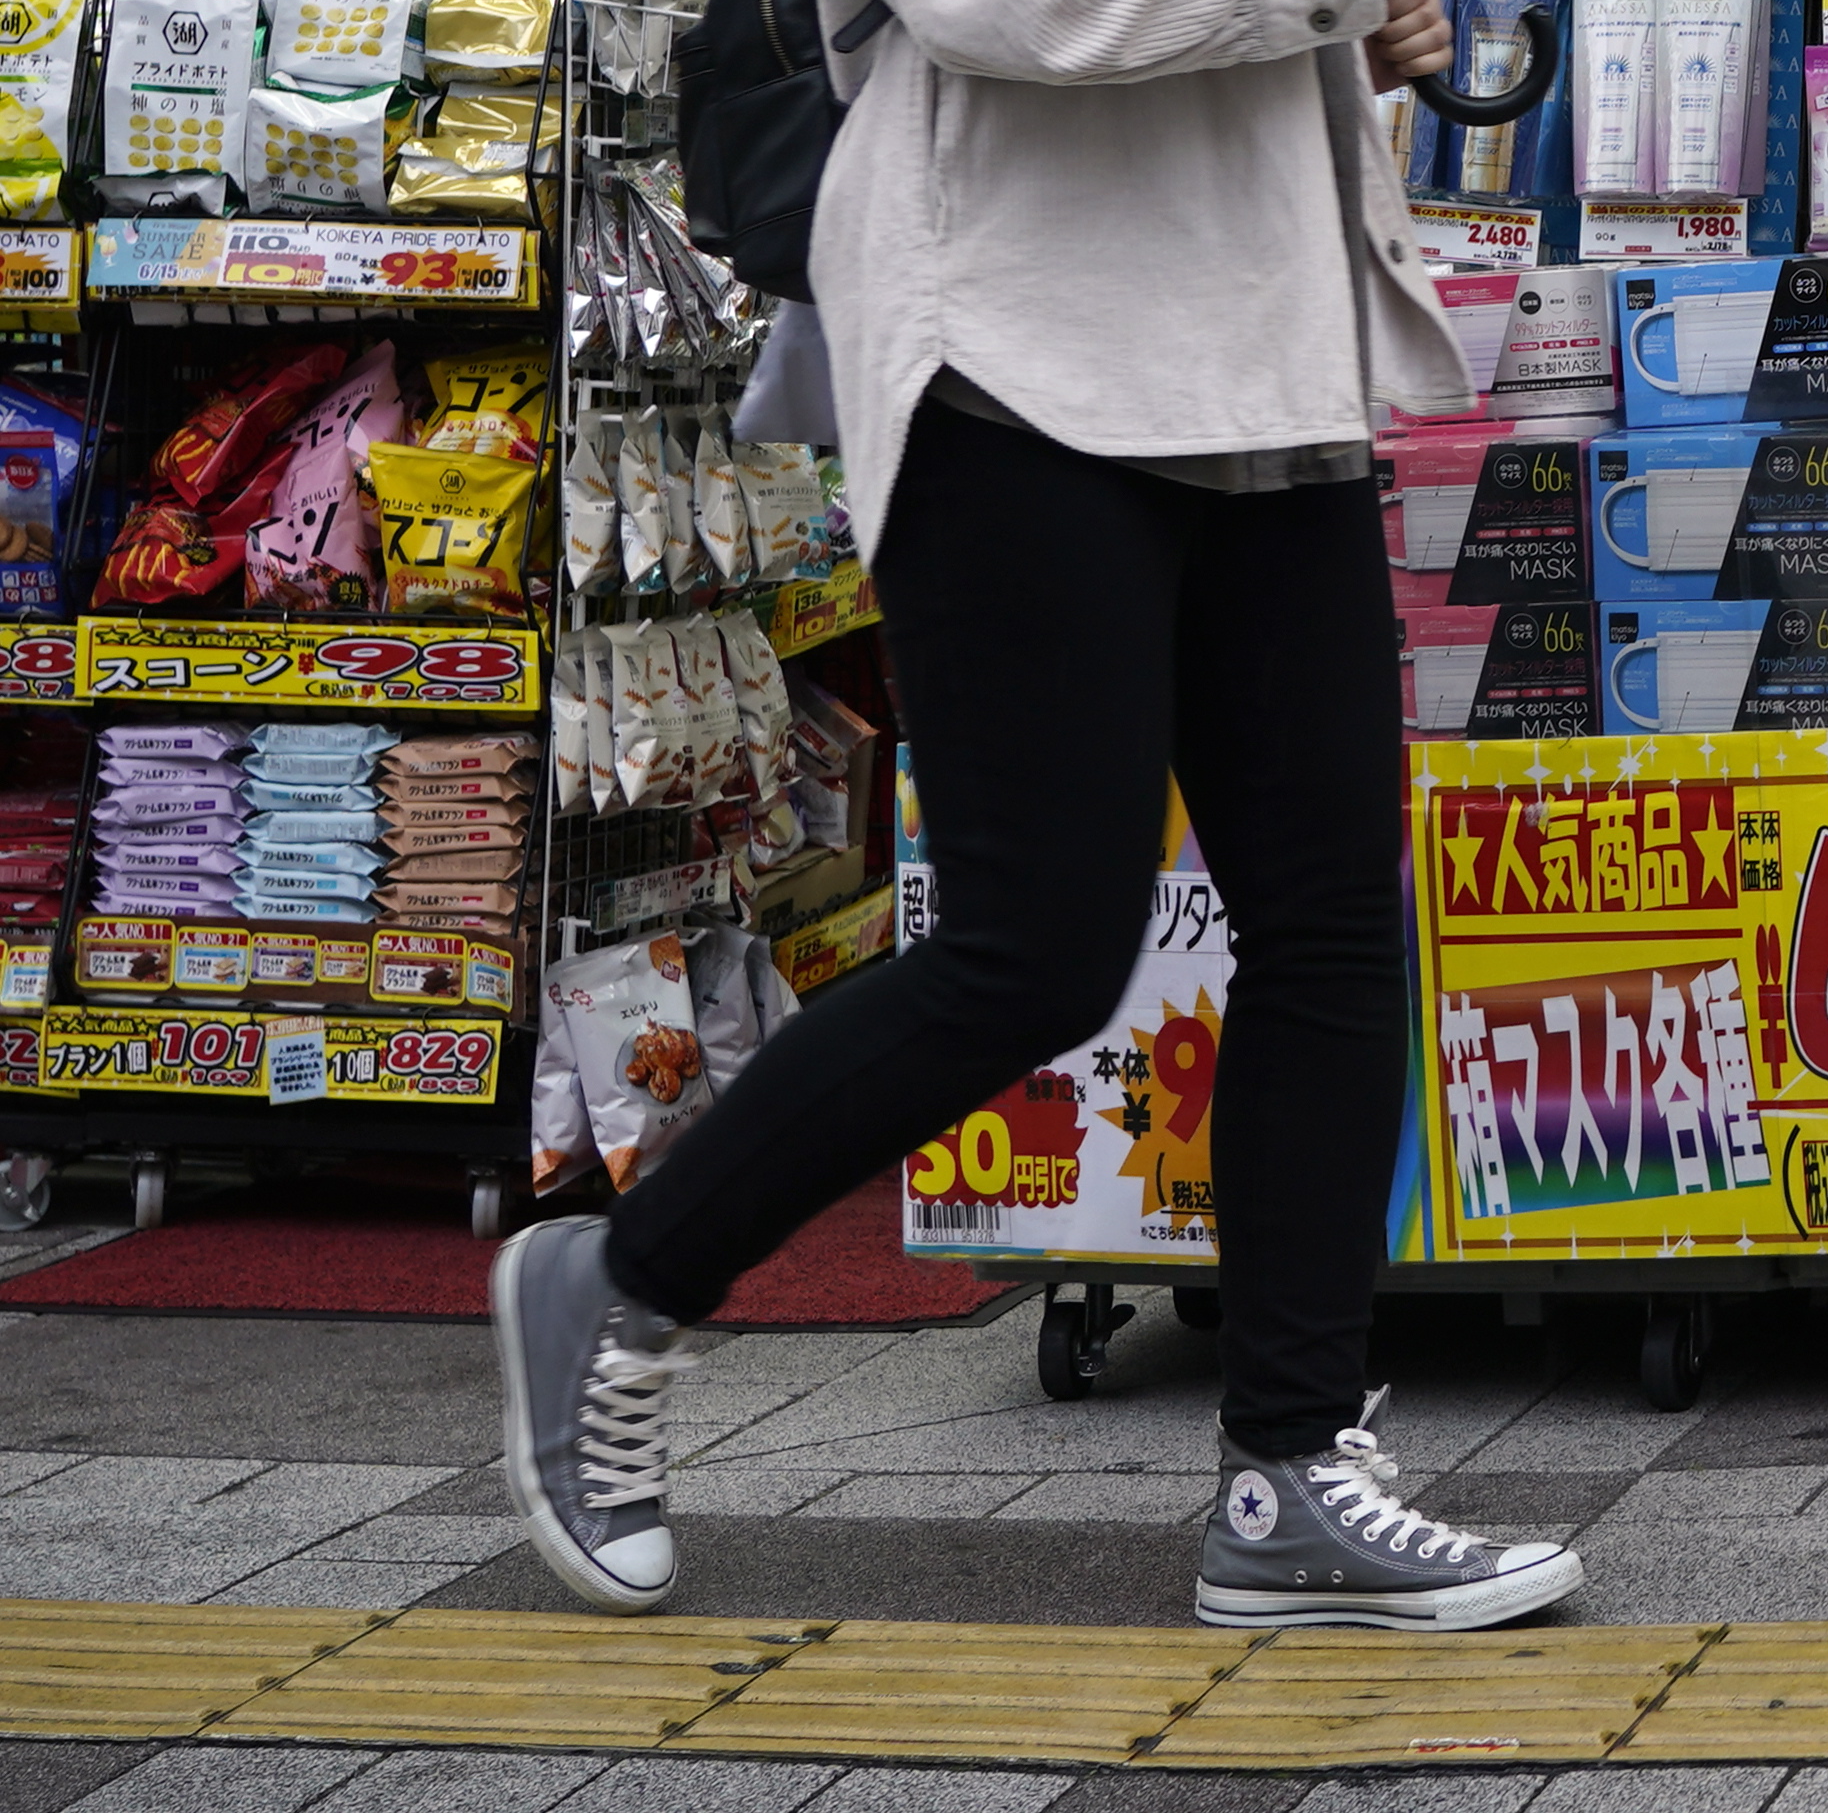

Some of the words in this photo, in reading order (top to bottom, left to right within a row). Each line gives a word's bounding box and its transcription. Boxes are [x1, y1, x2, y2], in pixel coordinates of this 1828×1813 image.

[133, 62, 229, 79] プライドポテト
[130, 94, 226, 116] 神のり塩
[132, 243, 206, 262] SALE
[315, 229, 385, 247] KOIKEYA
[390, 231, 437, 248] PRIDE
[444, 233, 510, 248] POTATO
[378, 254, 458, 287] 93
[1532, 452, 1562, 492] 66
[1464, 542, 1577, 559] 耳が痛くなりにくい
[1510, 559, 1577, 580] MASK
[93, 651, 292, 692] スコーン
[315, 636, 522, 681] 98
[158, 1021, 264, 1067] 101
[385, 1030, 493, 1075] 829
[1092, 1046, 1150, 1086] 本体
[1438, 956, 1769, 1222] 箱マスク各種
